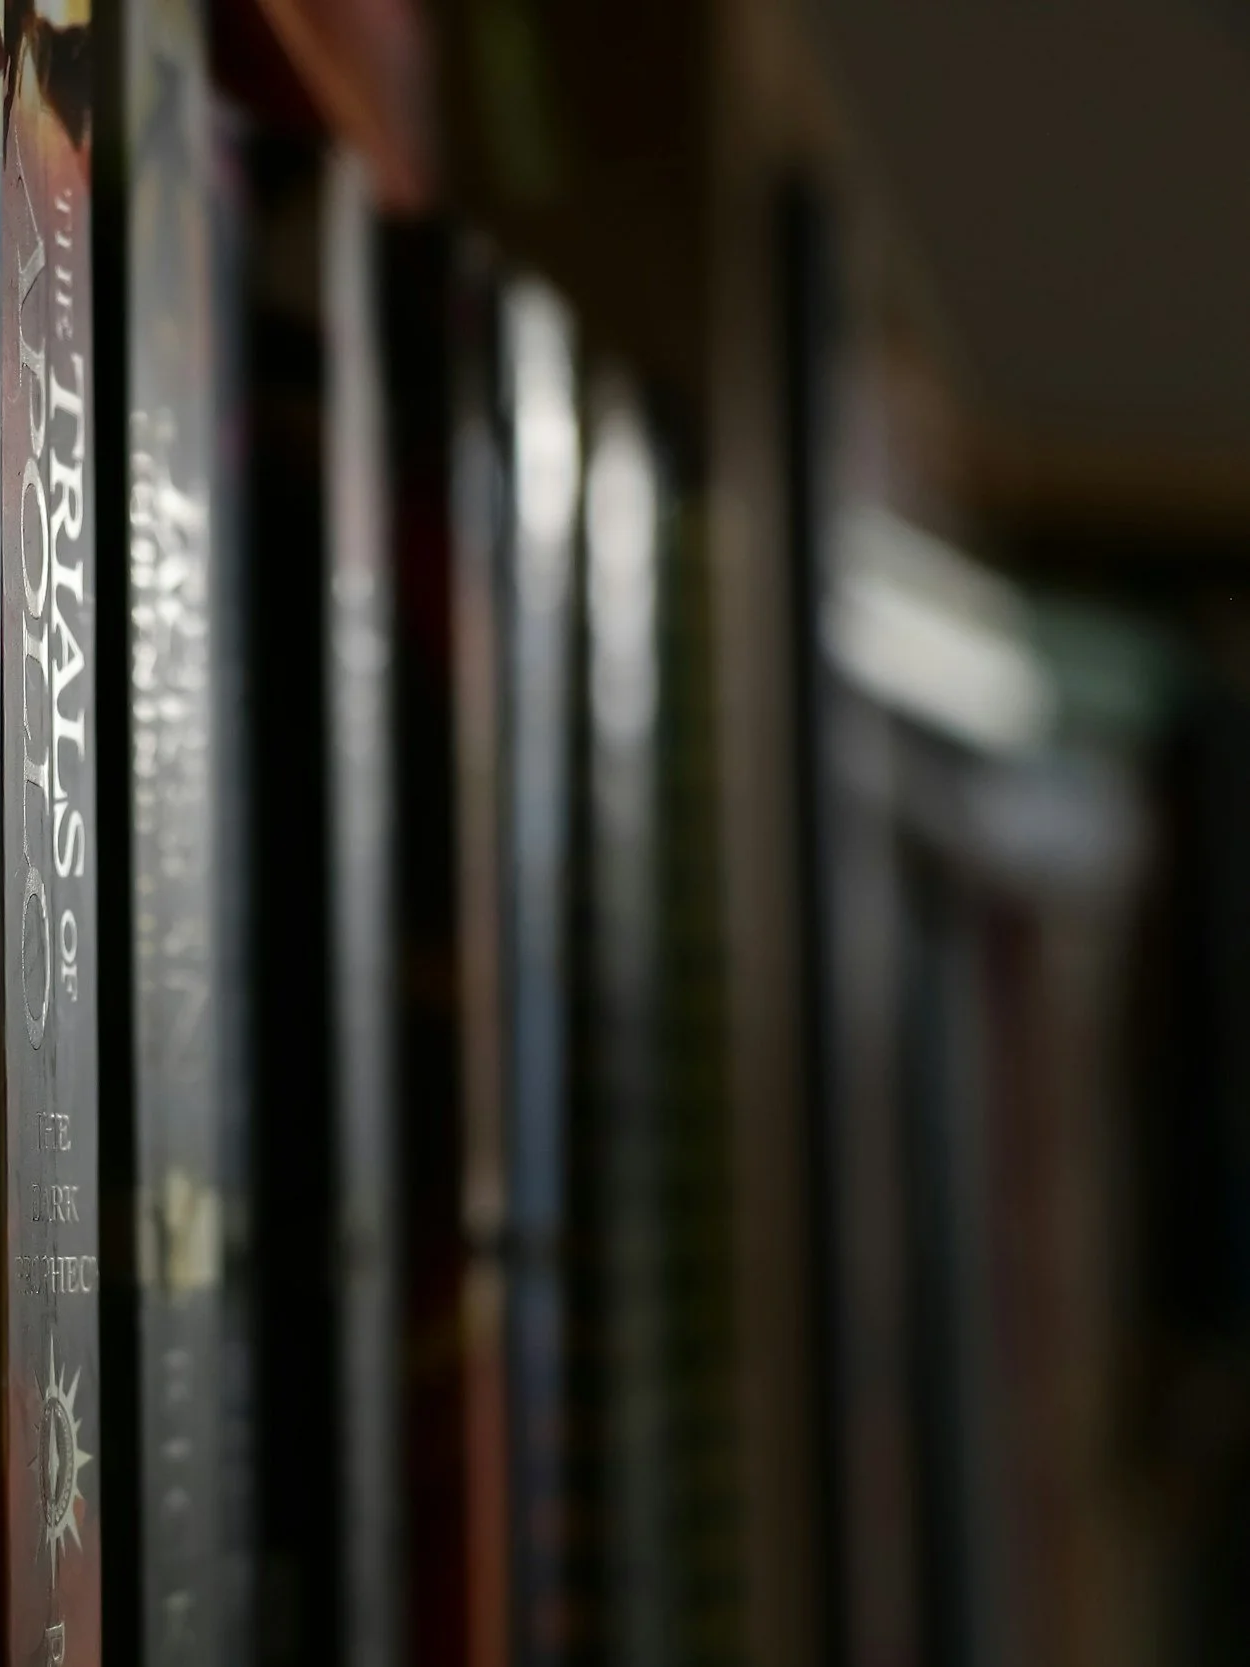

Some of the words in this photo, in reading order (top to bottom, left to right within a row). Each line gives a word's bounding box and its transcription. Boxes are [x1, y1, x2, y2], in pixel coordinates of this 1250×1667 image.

[13, 123, 51, 1051] APOLLO
[50, 351, 86, 878] TRIALS
[59, 908, 79, 1003] OF
[35, 1111, 72, 1151] THE
